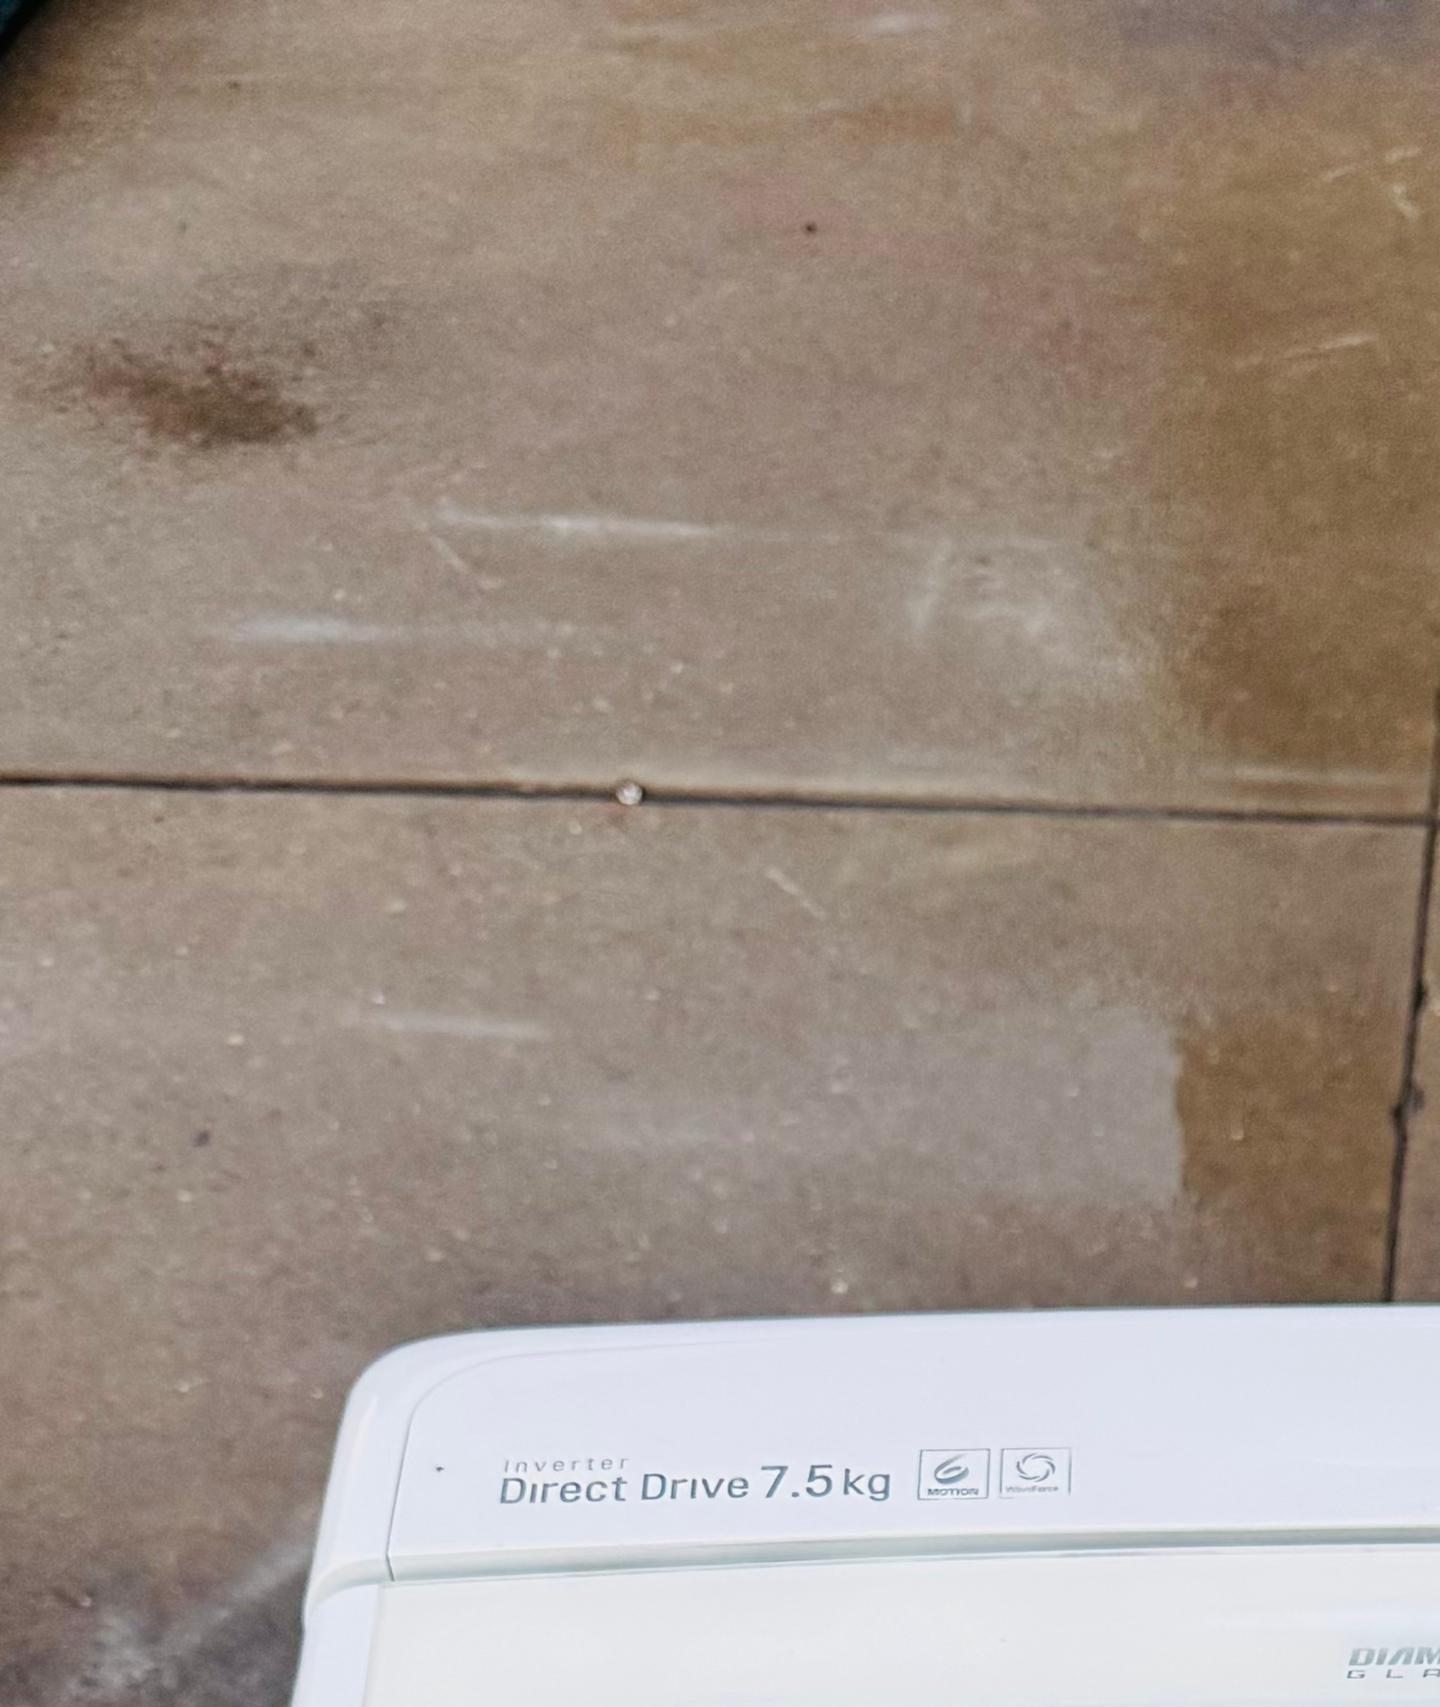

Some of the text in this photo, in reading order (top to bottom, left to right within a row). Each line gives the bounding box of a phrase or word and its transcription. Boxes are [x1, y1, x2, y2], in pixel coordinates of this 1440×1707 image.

[503, 1457, 629, 1473] Inverter
[499, 1476, 628, 1504] Direct
[641, 1473, 749, 1501] Drive
